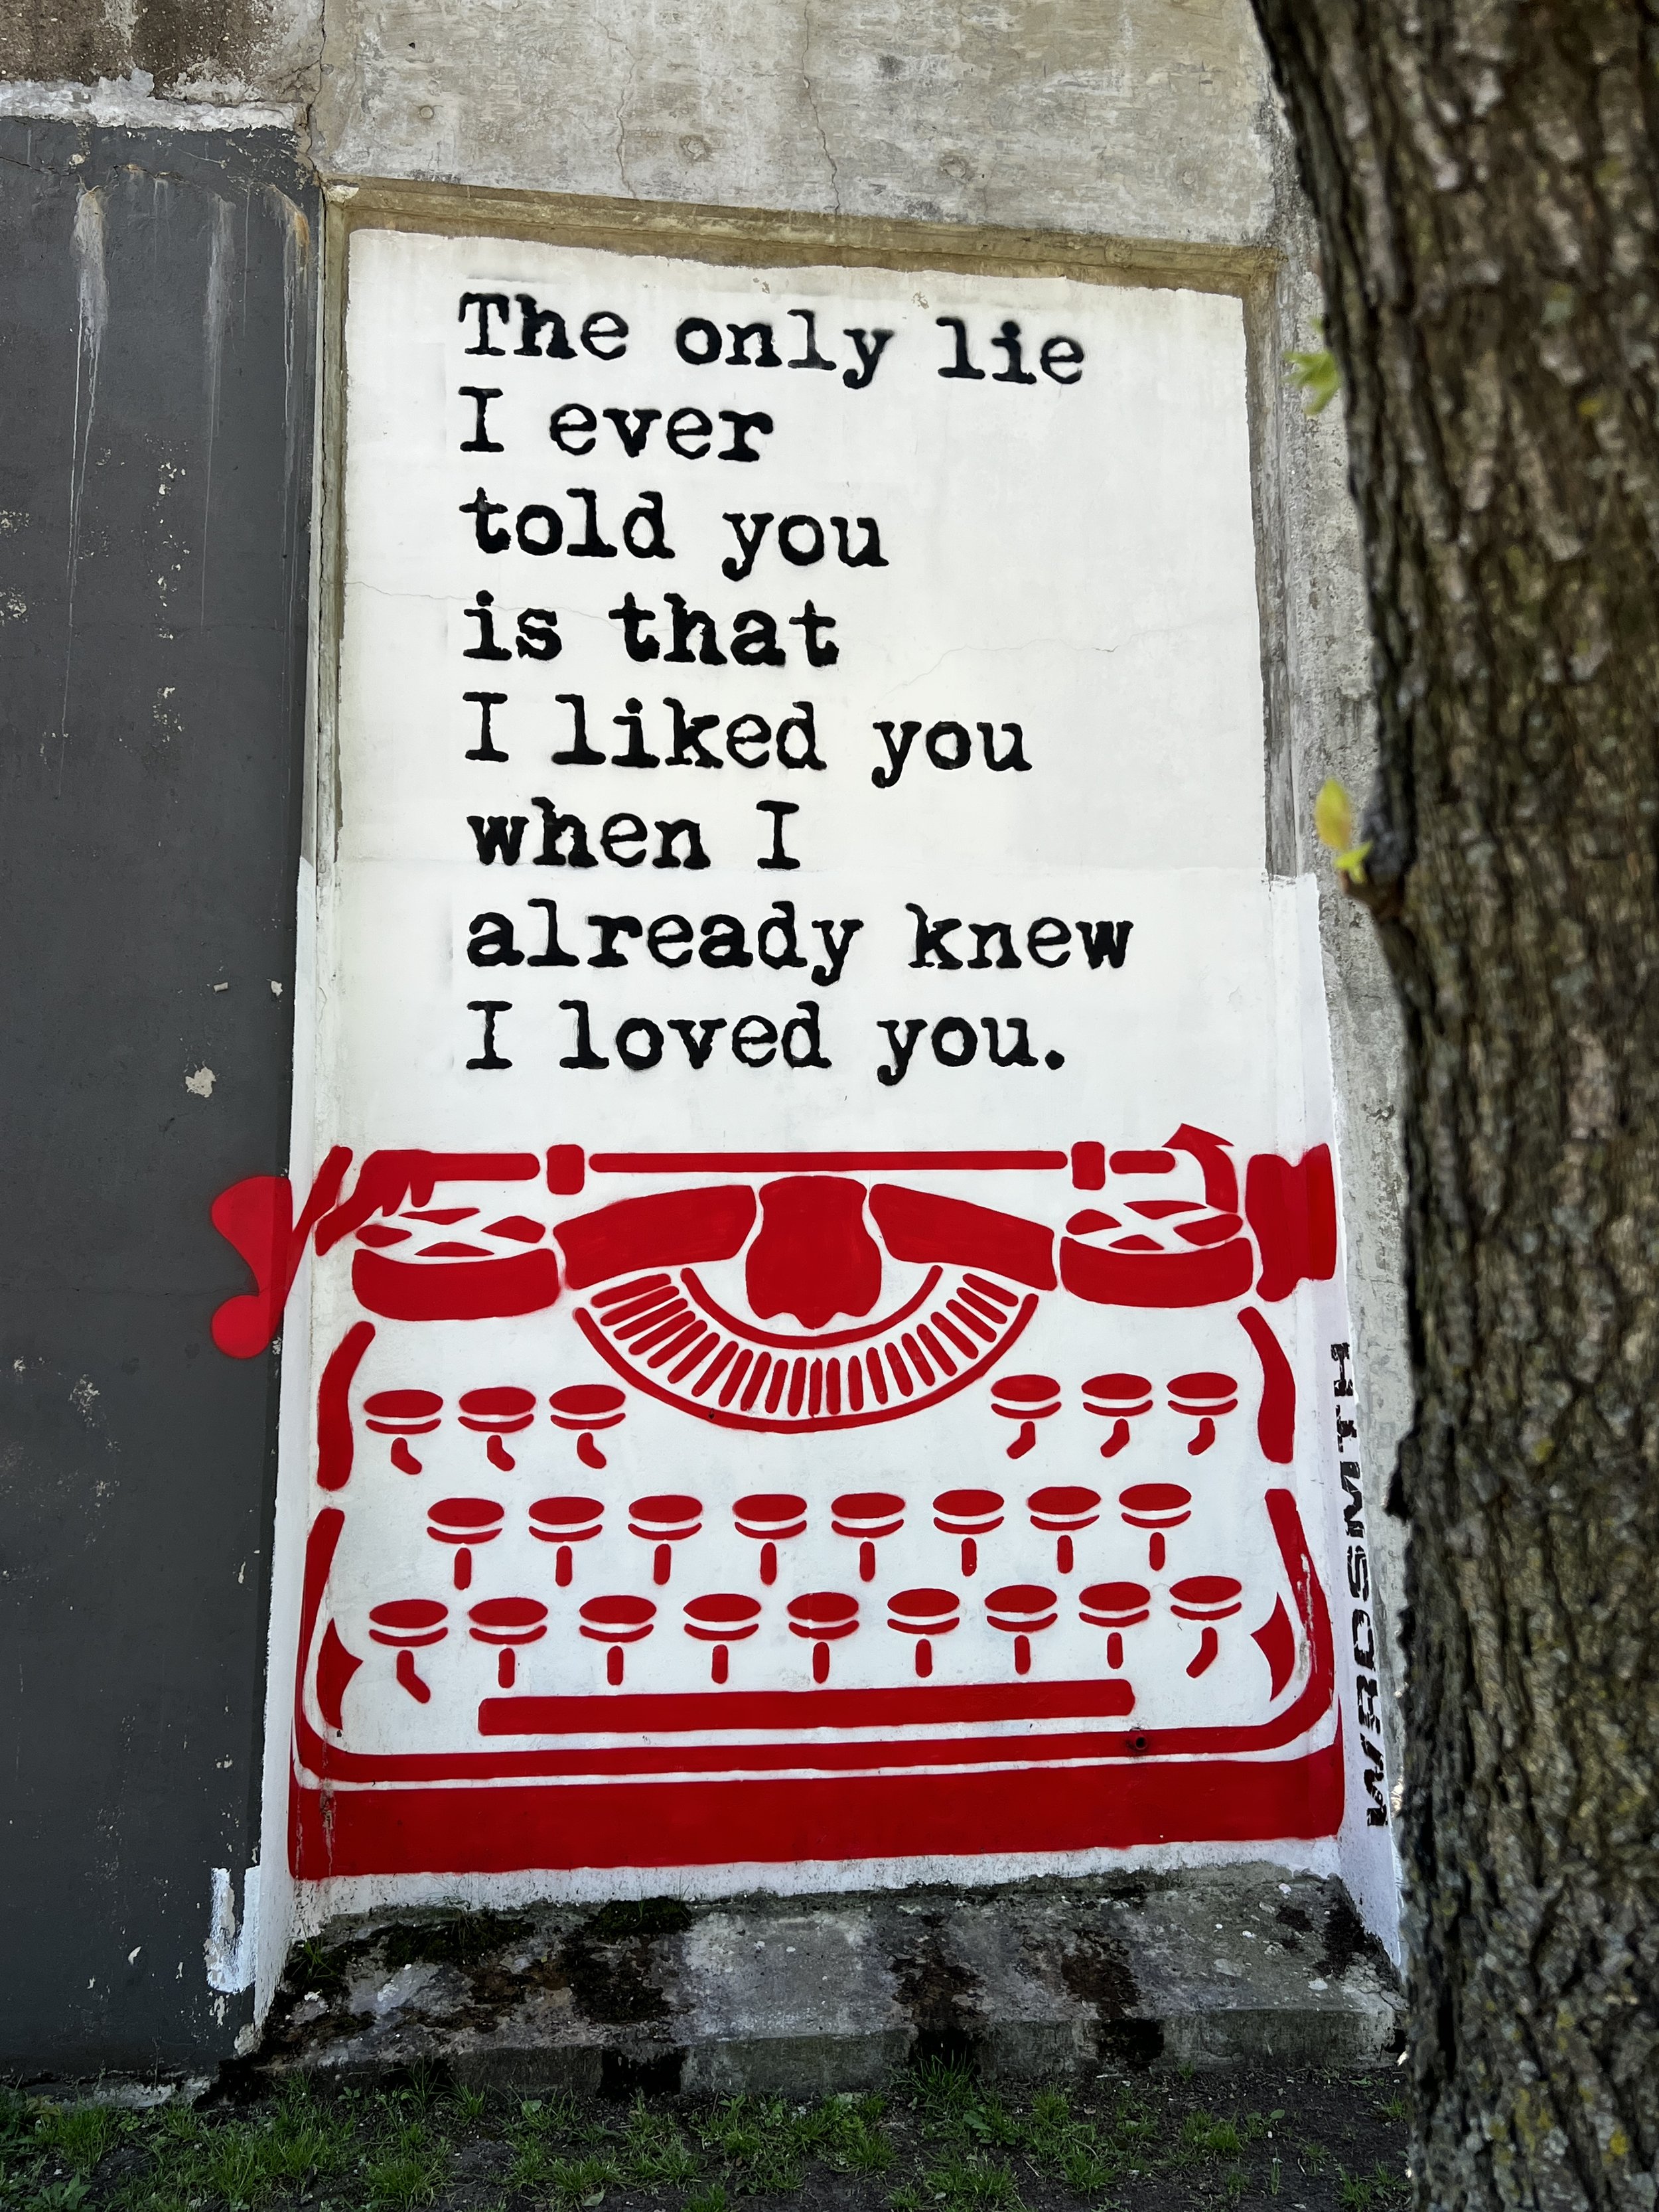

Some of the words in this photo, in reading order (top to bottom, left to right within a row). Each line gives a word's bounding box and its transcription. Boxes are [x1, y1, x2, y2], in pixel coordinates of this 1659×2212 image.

[458, 291, 630, 361] The
[675, 309, 895, 390] only
[936, 317, 1085, 385] lie
[458, 386, 505, 453] I
[549, 402, 774, 463] ever
[459, 486, 676, 559] told
[721, 512, 890, 582] you
[463, 589, 563, 662] is
[608, 591, 839, 668] that
[462, 692, 509, 763] I
[551, 694, 828, 771] liked
[871, 719, 1033, 789] you
[466, 796, 711, 870] when
[756, 800, 801, 871] I
[467, 898, 864, 987] already
[905, 903, 1135, 970] knew
[466, 1000, 513, 1070] I
[558, 999, 833, 1072] loved
[877, 1016, 1065, 1086] you.
[1331, 1342, 1388, 1827] WRDSMTH
